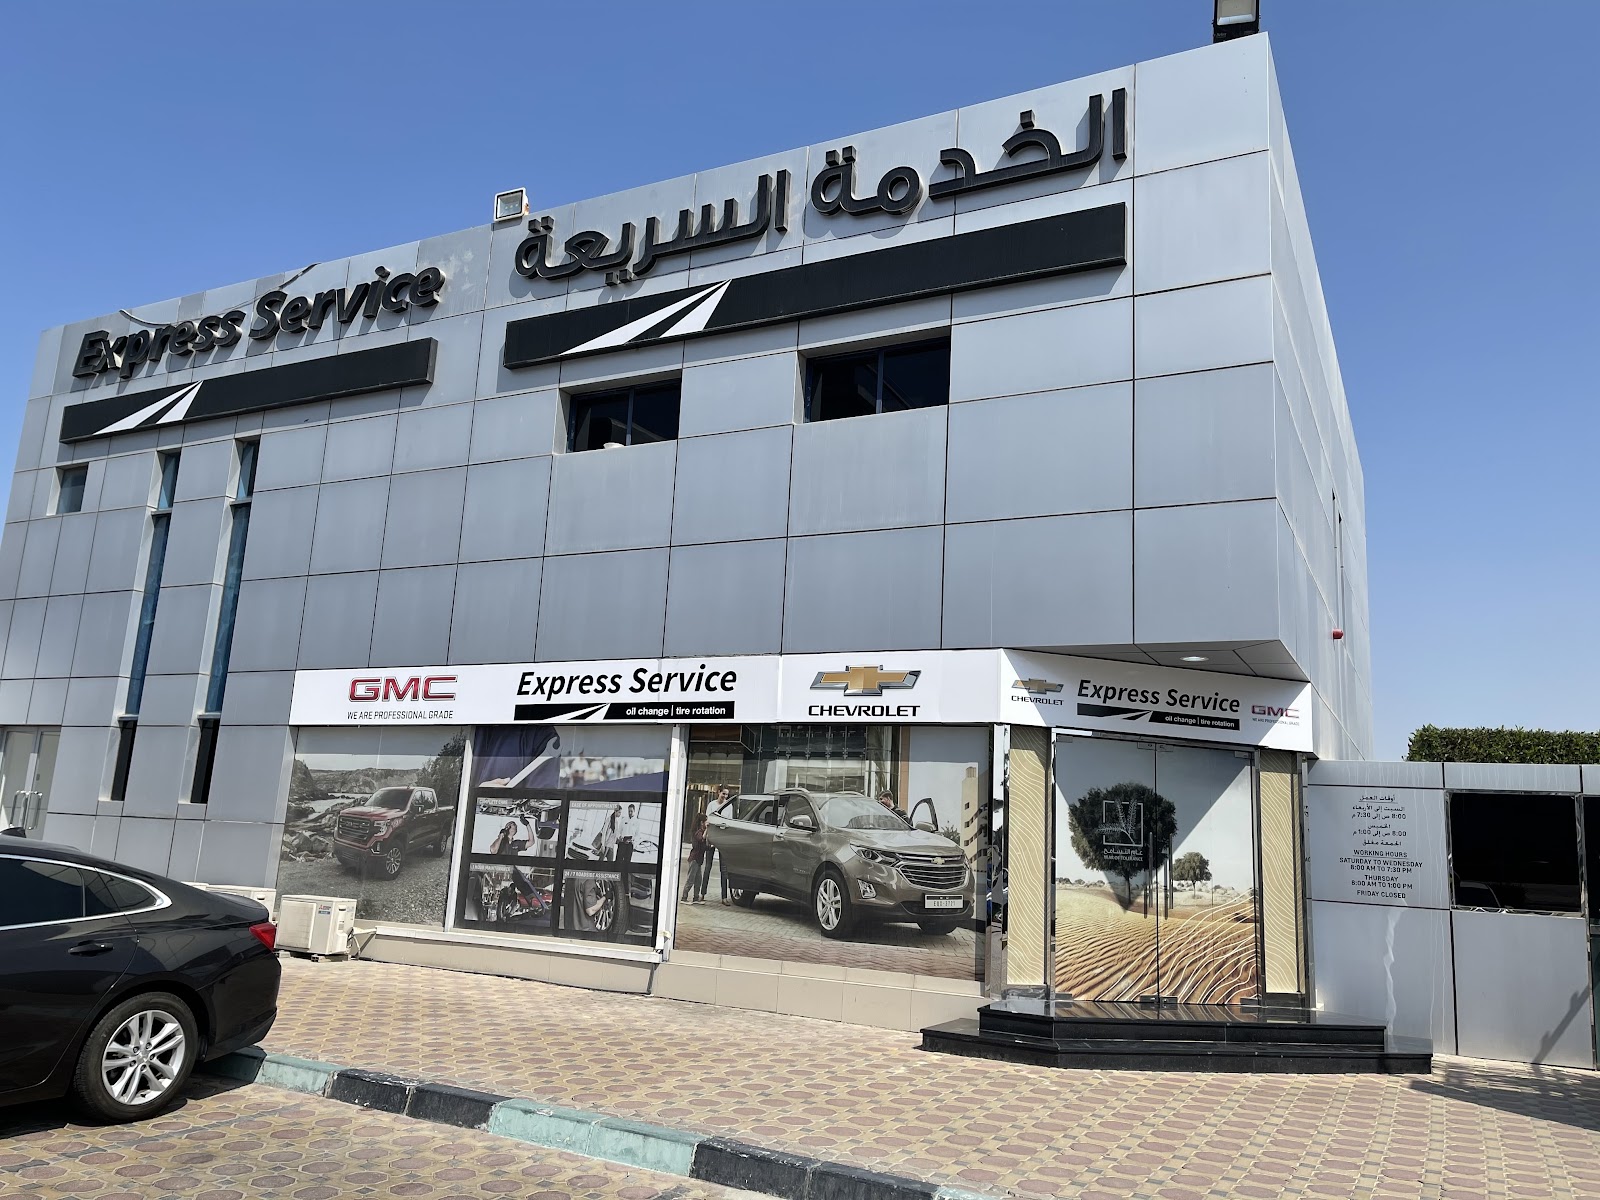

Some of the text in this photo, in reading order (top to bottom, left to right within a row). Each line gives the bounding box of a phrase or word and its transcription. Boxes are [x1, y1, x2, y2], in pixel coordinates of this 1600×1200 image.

[514, 87, 1128, 286] الخدمة السريعة
[72, 265, 447, 379] Express Service
[348, 674, 458, 702] GMC
[516, 663, 737, 702] Express Service
[1011, 695, 1064, 706] CHEVROLET
[1077, 679, 1240, 712] Express Service
[347, 710, 454, 720] WE ARE PROFESSIONAL GRADE
[626, 704, 726, 718] oil change tire rotation
[808, 705, 921, 716] CHEVROLET
[1251, 704, 1300, 718] GMC
[1174, 716, 1196, 724] change
[1212, 720, 1235, 728] rotation
